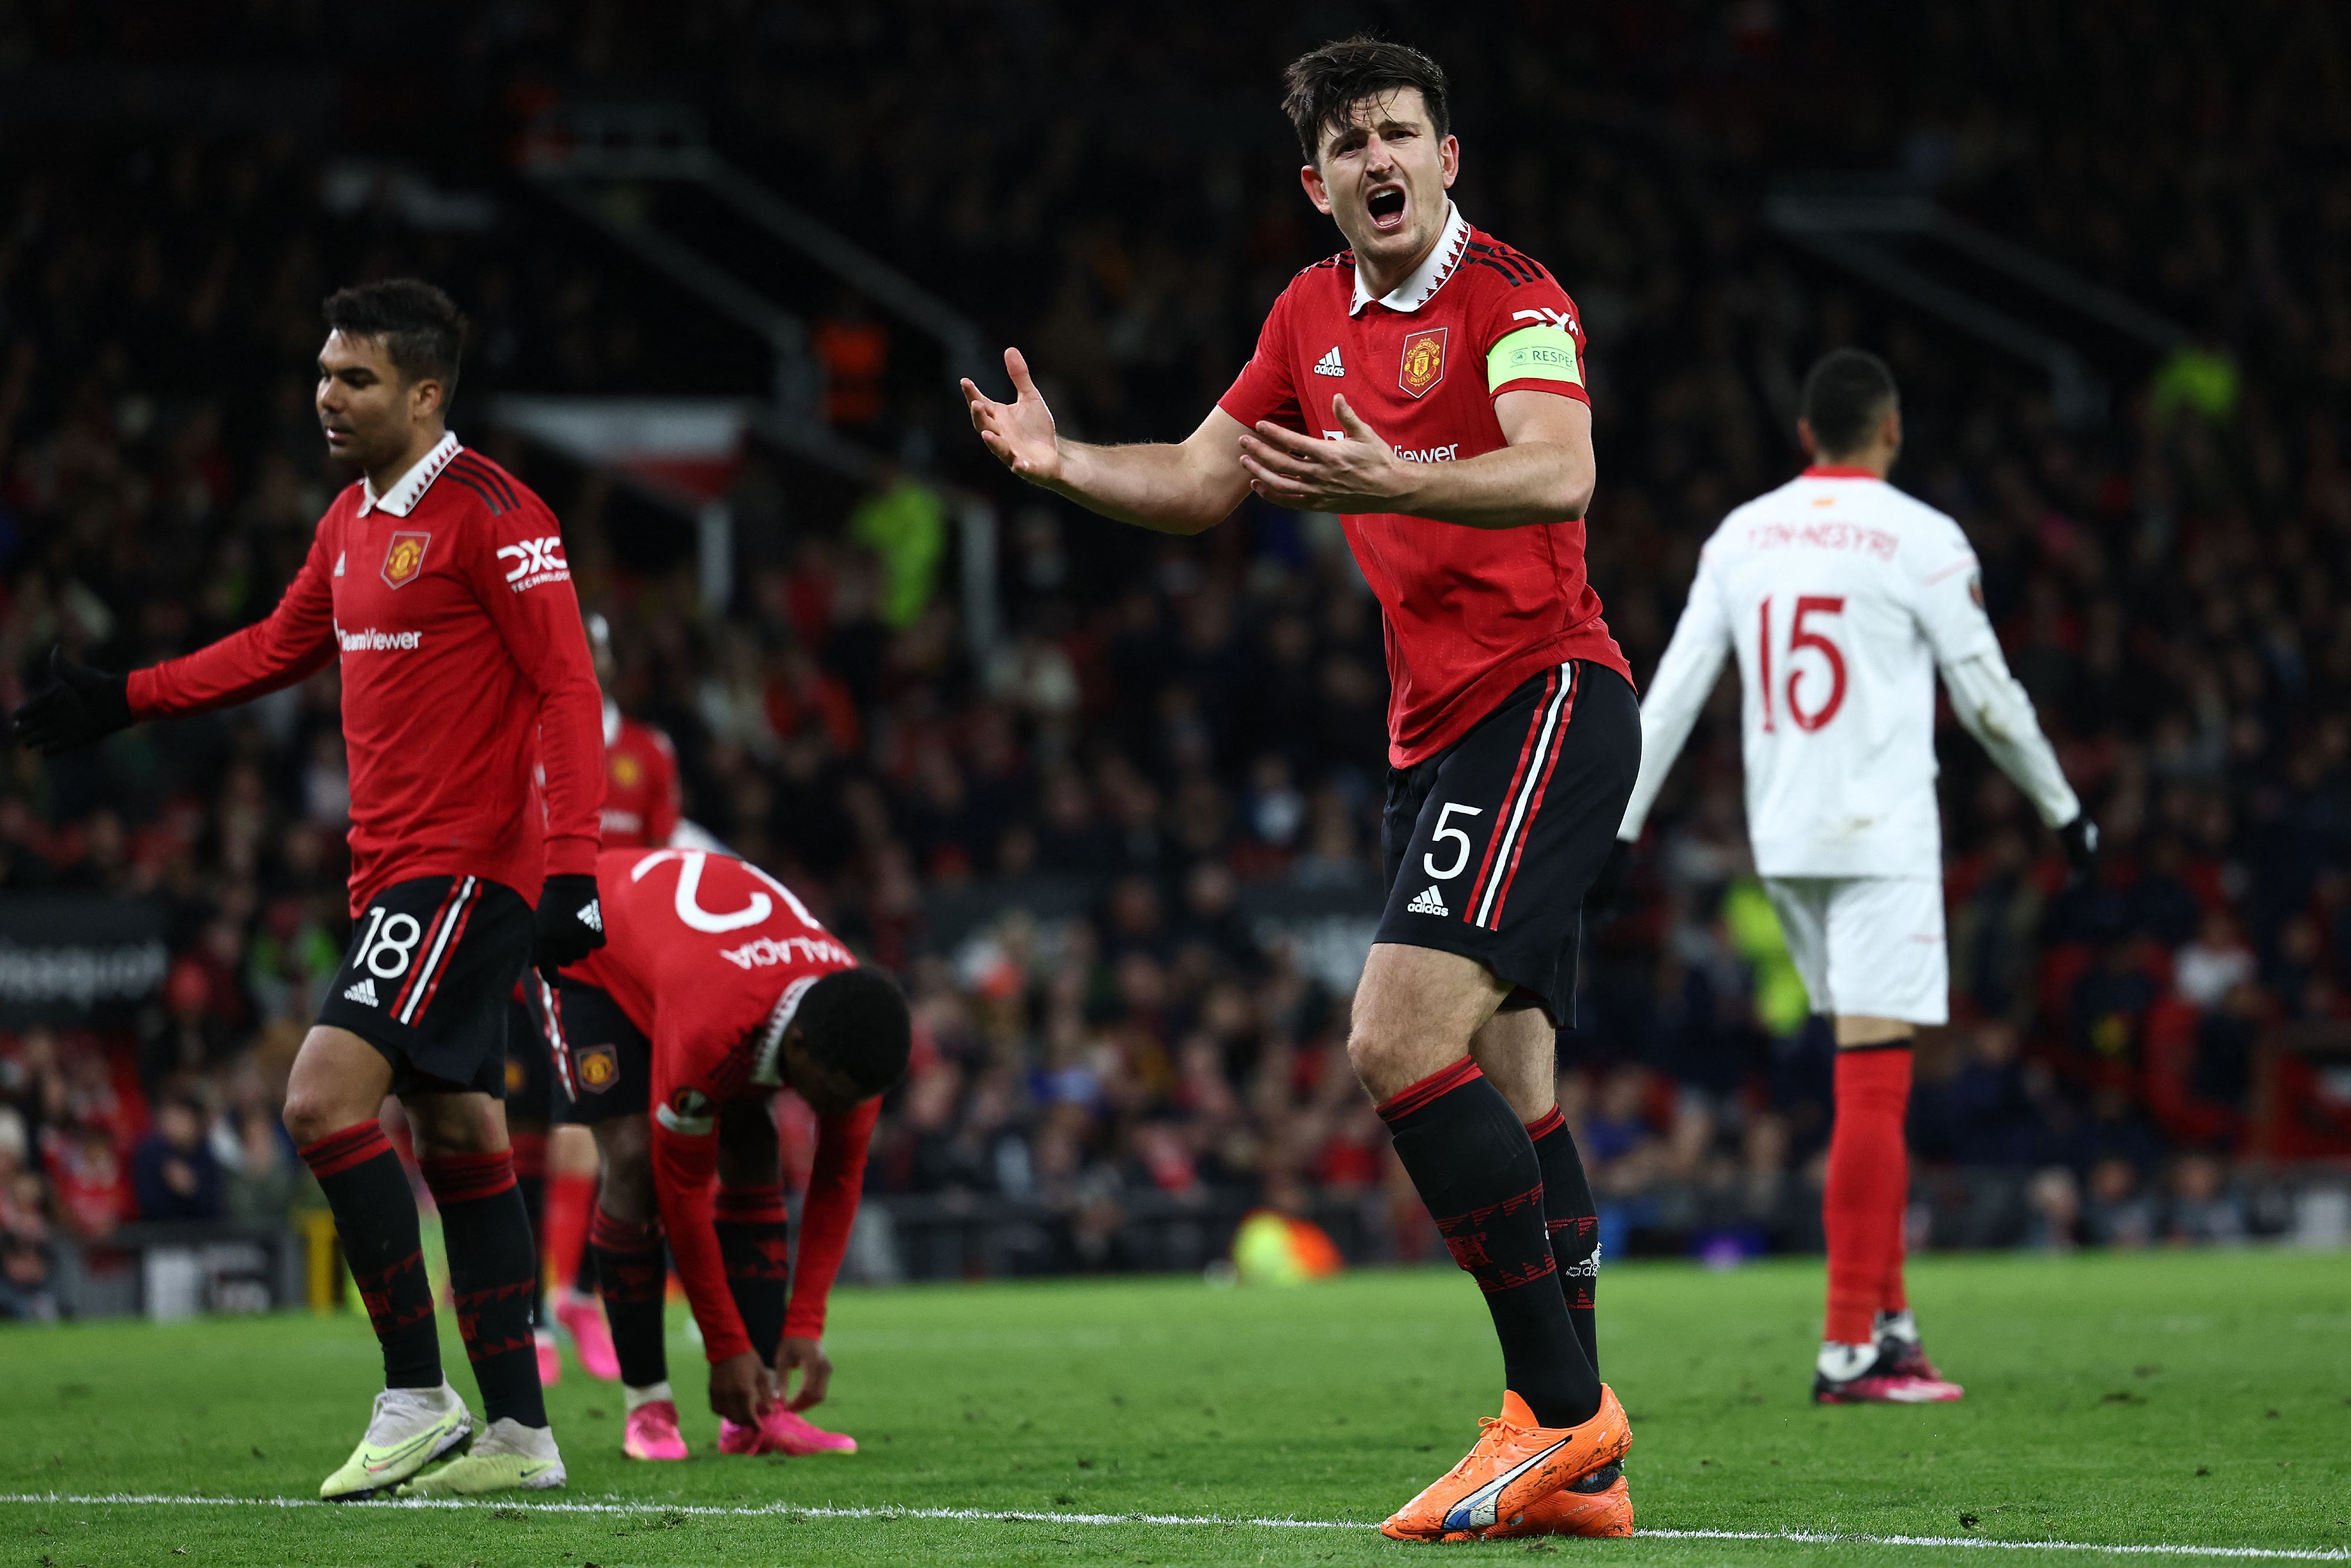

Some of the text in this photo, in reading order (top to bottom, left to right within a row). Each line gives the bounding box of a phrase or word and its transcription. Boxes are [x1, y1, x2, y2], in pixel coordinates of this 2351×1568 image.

[1409, 341, 1438, 359] MANCHESTER
[1532, 351, 1575, 368] RESPEC
[1314, 363, 1345, 377] adidas
[1411, 373, 1431, 384] UNITED
[496, 536, 568, 583] DXC
[1758, 595, 1846, 732] 15
[1424, 802, 1483, 880] 5
[1407, 903, 1449, 917] adidas
[353, 906, 421, 979] 18
[1562, 1503, 1590, 1517] ULTRA
